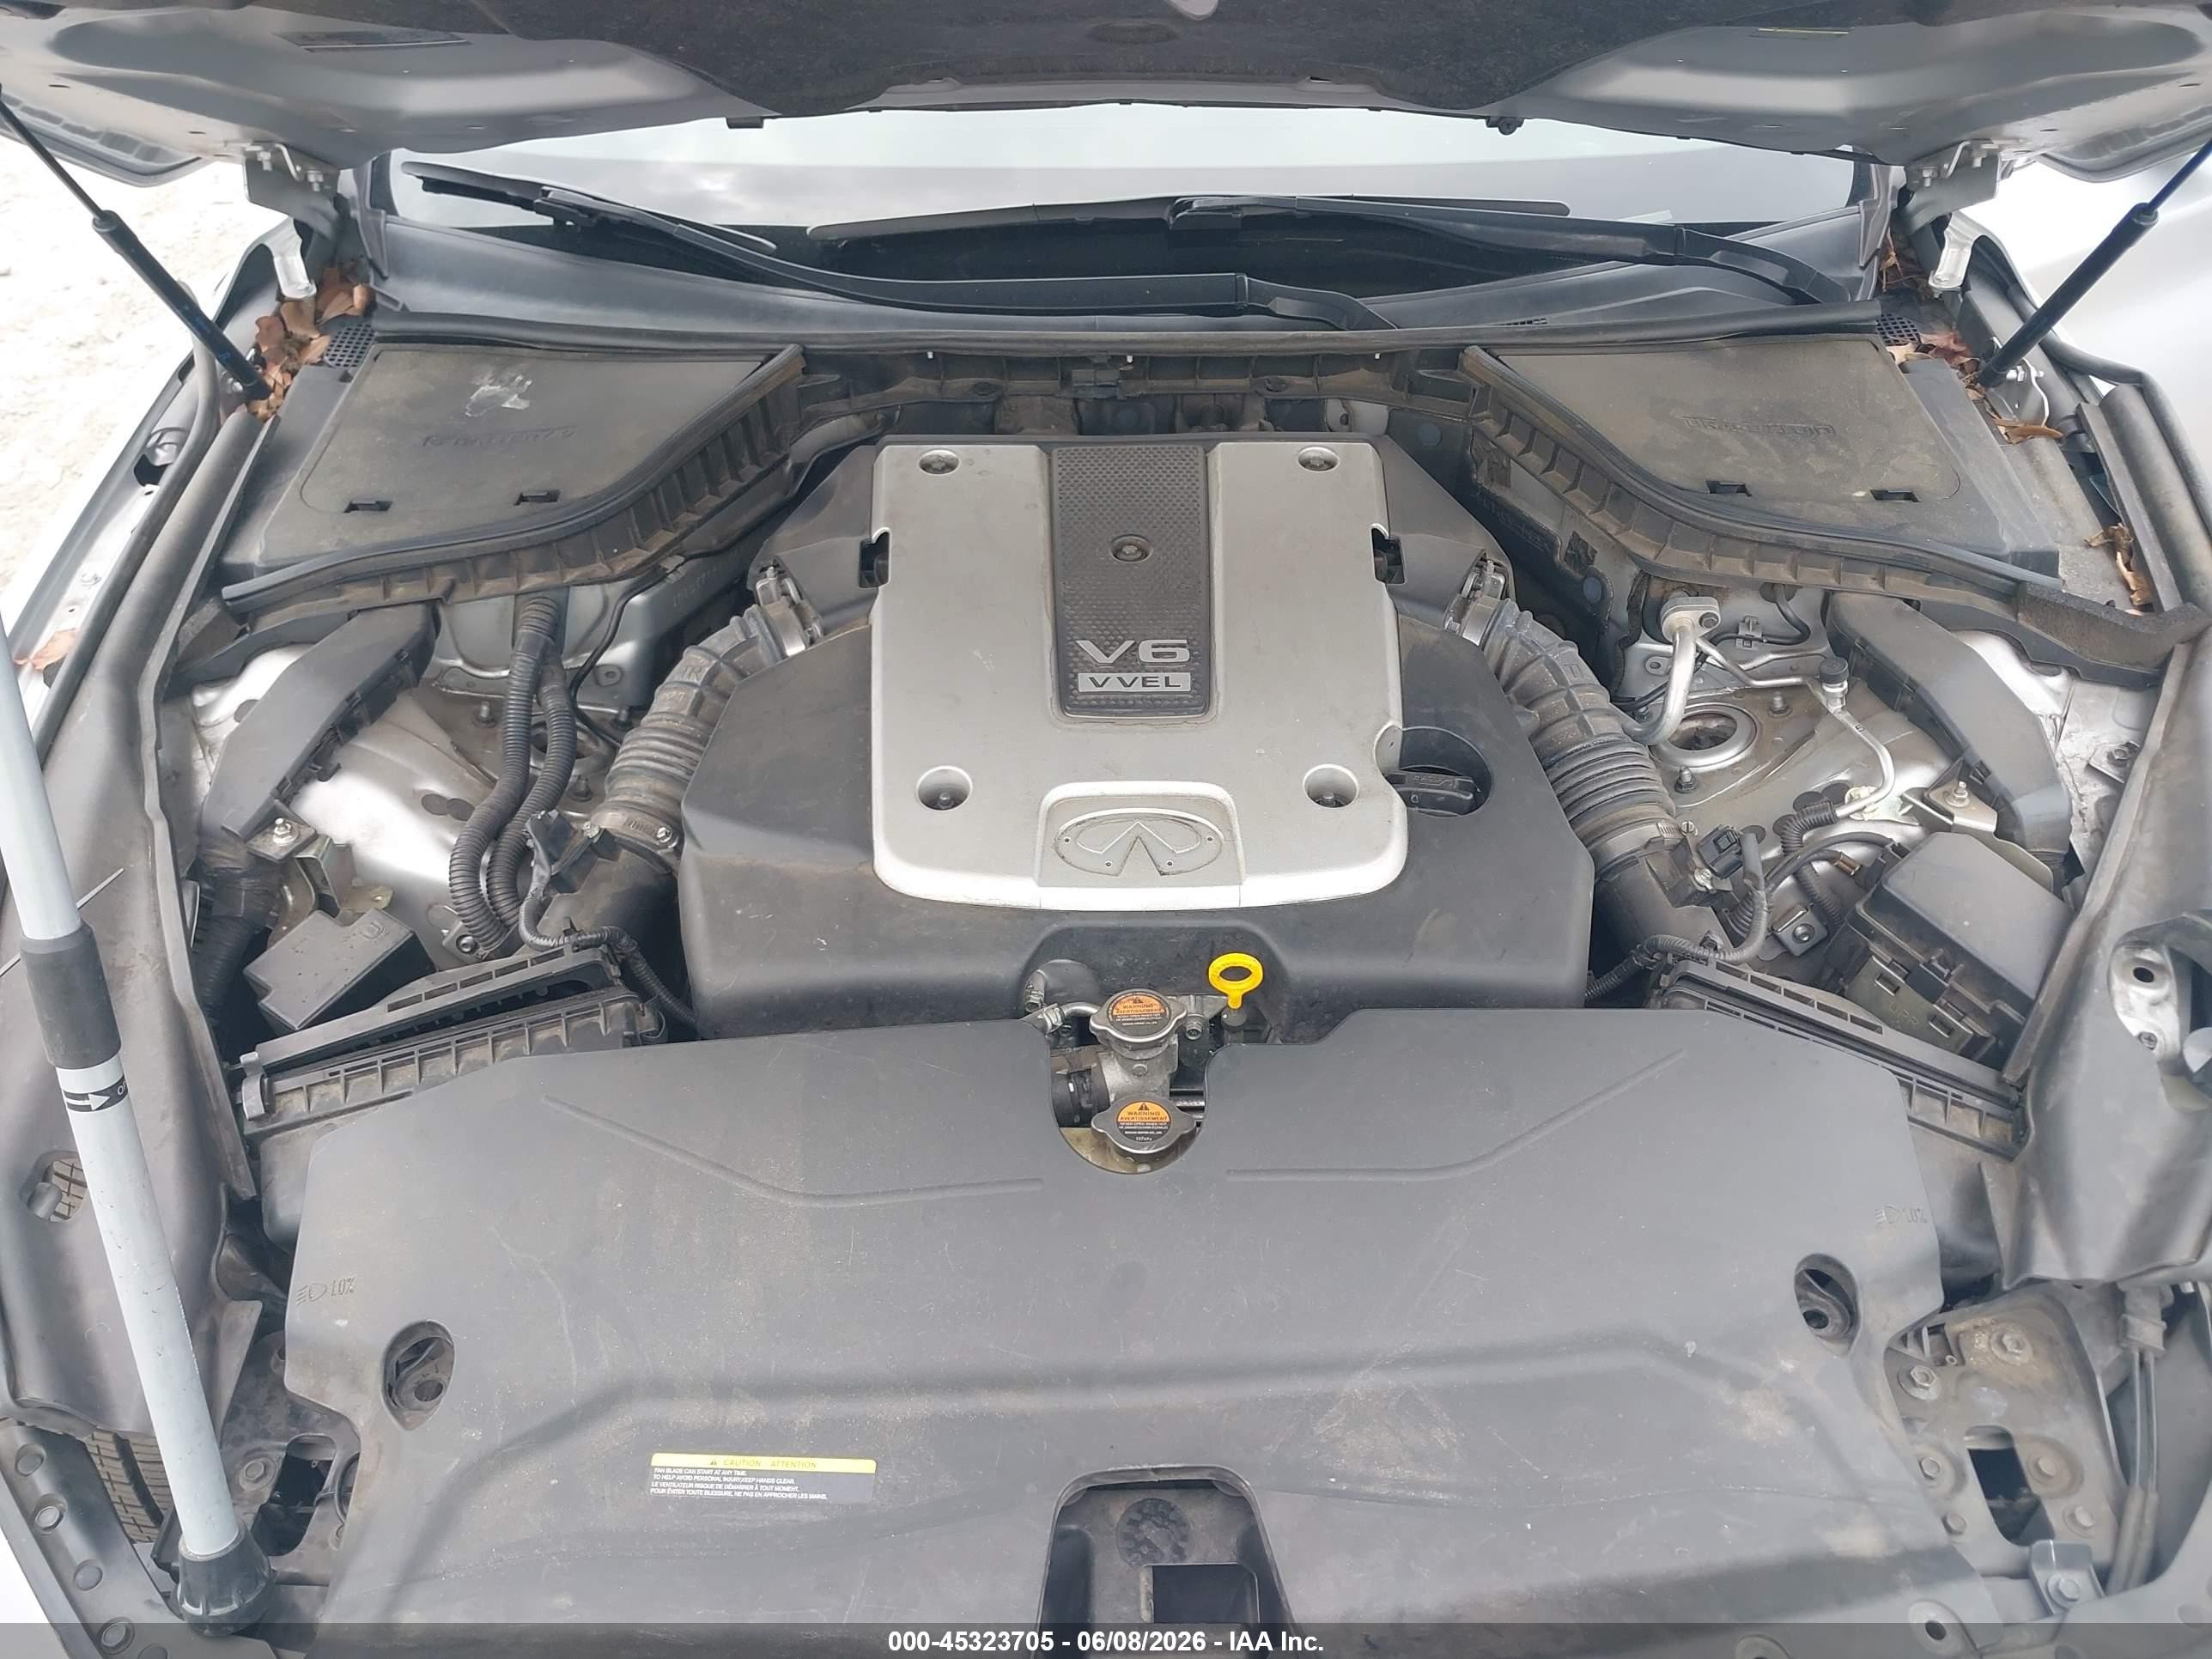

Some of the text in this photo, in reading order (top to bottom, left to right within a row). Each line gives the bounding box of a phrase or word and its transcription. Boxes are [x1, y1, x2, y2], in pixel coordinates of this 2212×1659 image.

[1076, 639, 1190, 663] V6
[1088, 675, 1182, 688] VVEL
[770, 1461, 817, 1469] ATTENTION
